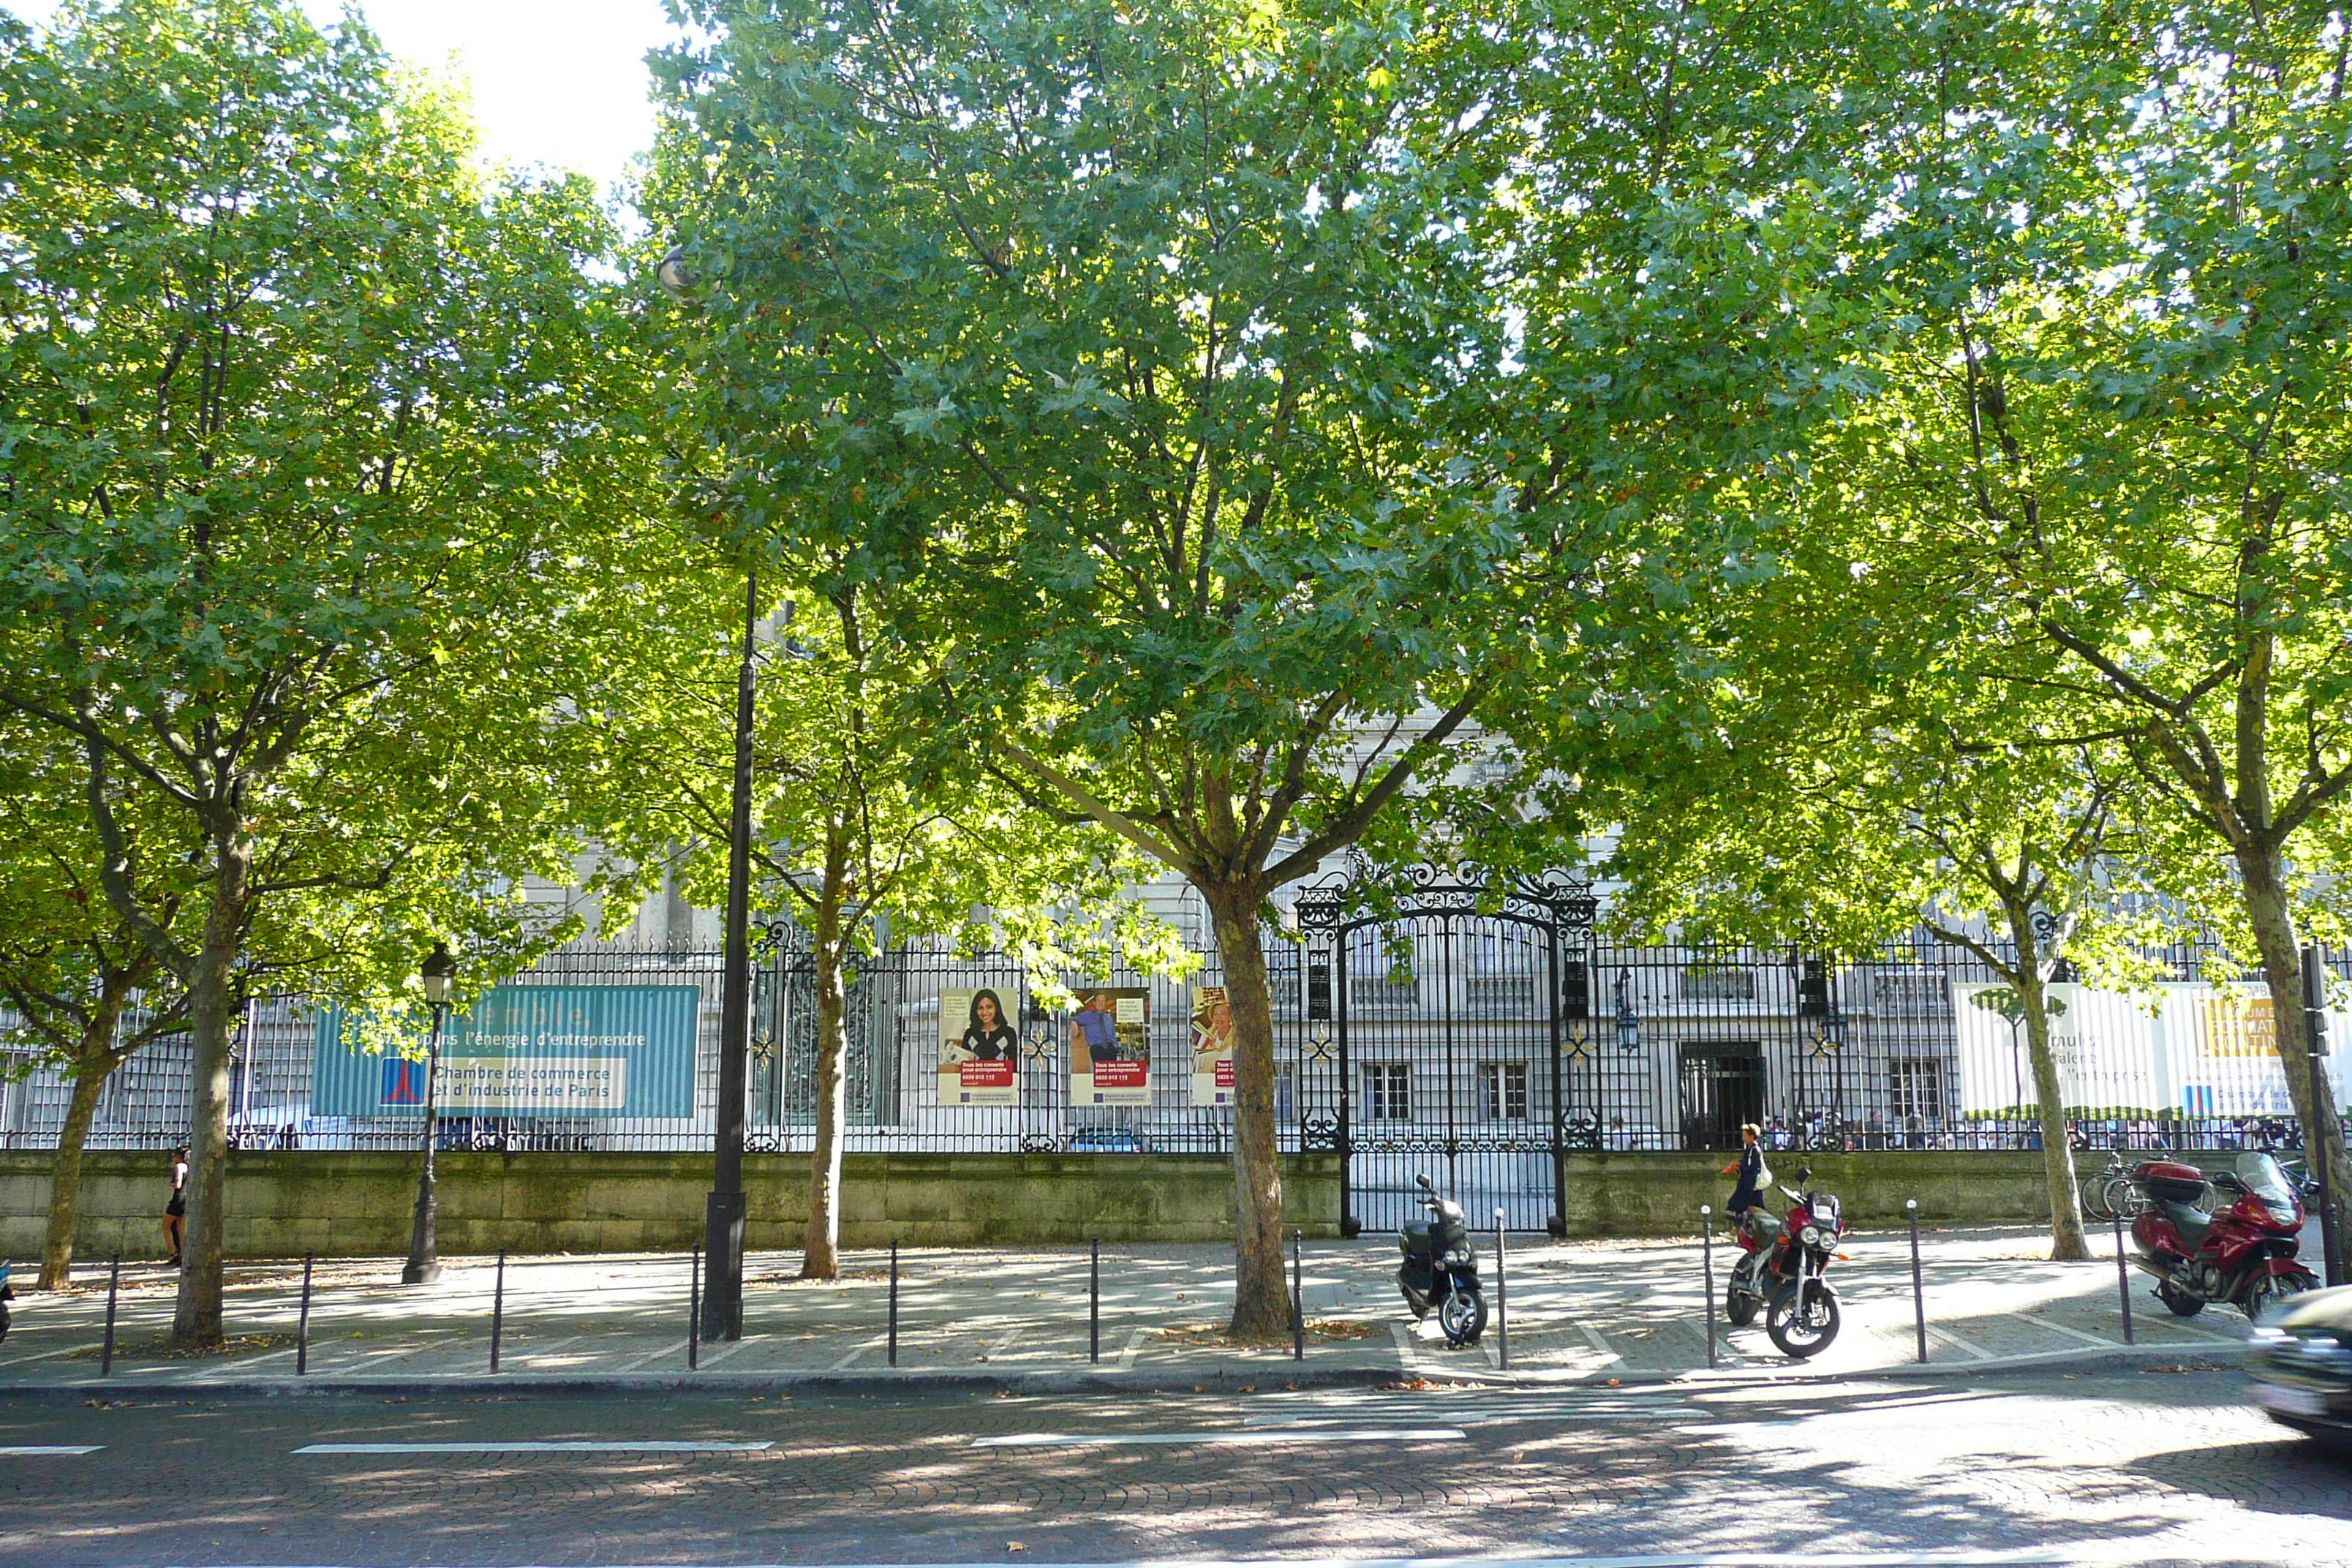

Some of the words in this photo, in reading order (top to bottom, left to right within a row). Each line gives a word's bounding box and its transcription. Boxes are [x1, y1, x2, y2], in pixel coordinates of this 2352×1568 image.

[466, 1031, 529, 1049] l'énergie
[537, 1031, 646, 1049] d'entreprendre
[2214, 1035, 2277, 1049] CONTIN
[437, 1066, 503, 1079] Chambre
[508, 1066, 526, 1079] de
[531, 1069, 610, 1079] commerce
[435, 1085, 448, 1096] et
[454, 1084, 539, 1096] d'industrie
[545, 1084, 562, 1096] de
[569, 1084, 609, 1097] Paris
